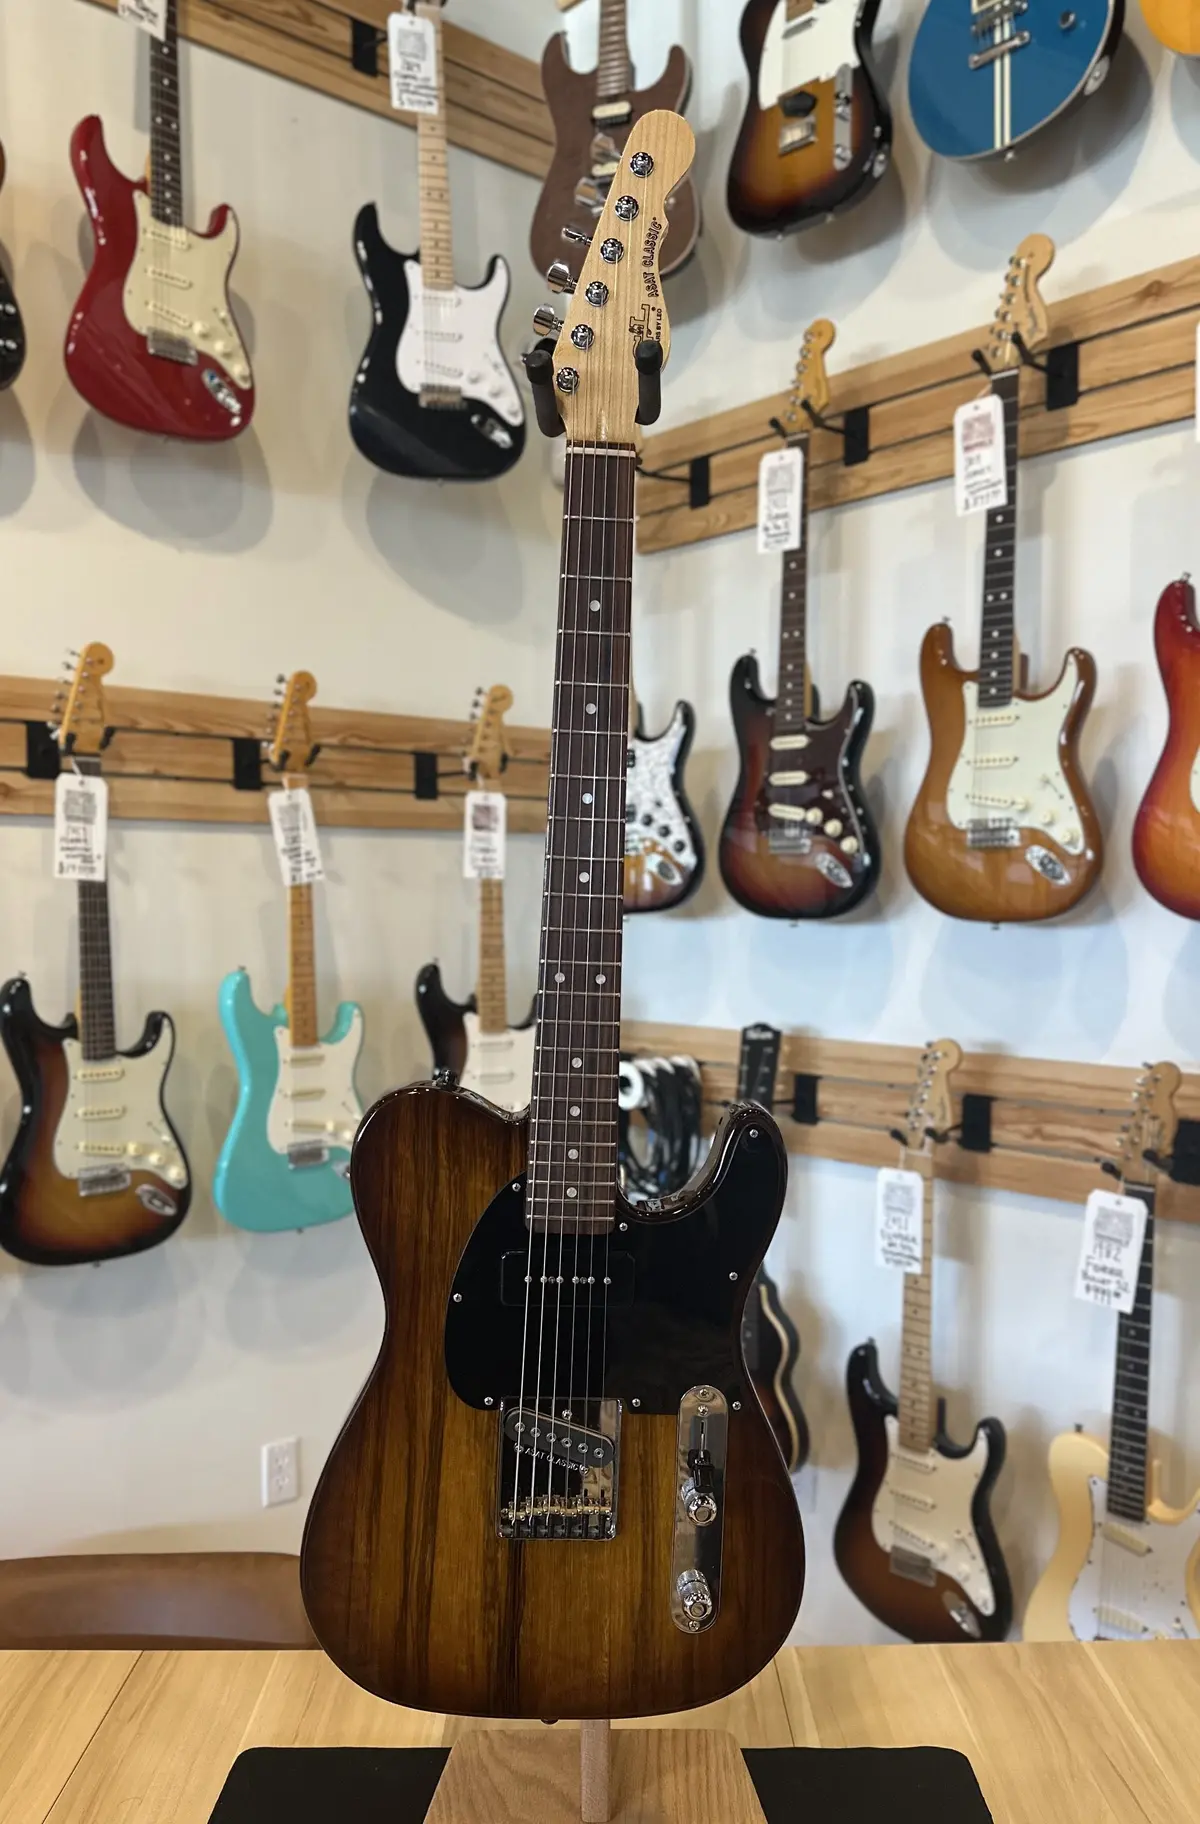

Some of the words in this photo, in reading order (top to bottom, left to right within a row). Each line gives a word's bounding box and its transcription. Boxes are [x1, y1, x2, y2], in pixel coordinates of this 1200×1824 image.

[641, 219, 662, 268] CLASSIC
[642, 271, 660, 298] ASAT
[655, 321, 662, 331] BY
[524, 1447, 546, 1460] ASAT
[546, 1454, 579, 1472] CLASSIC
